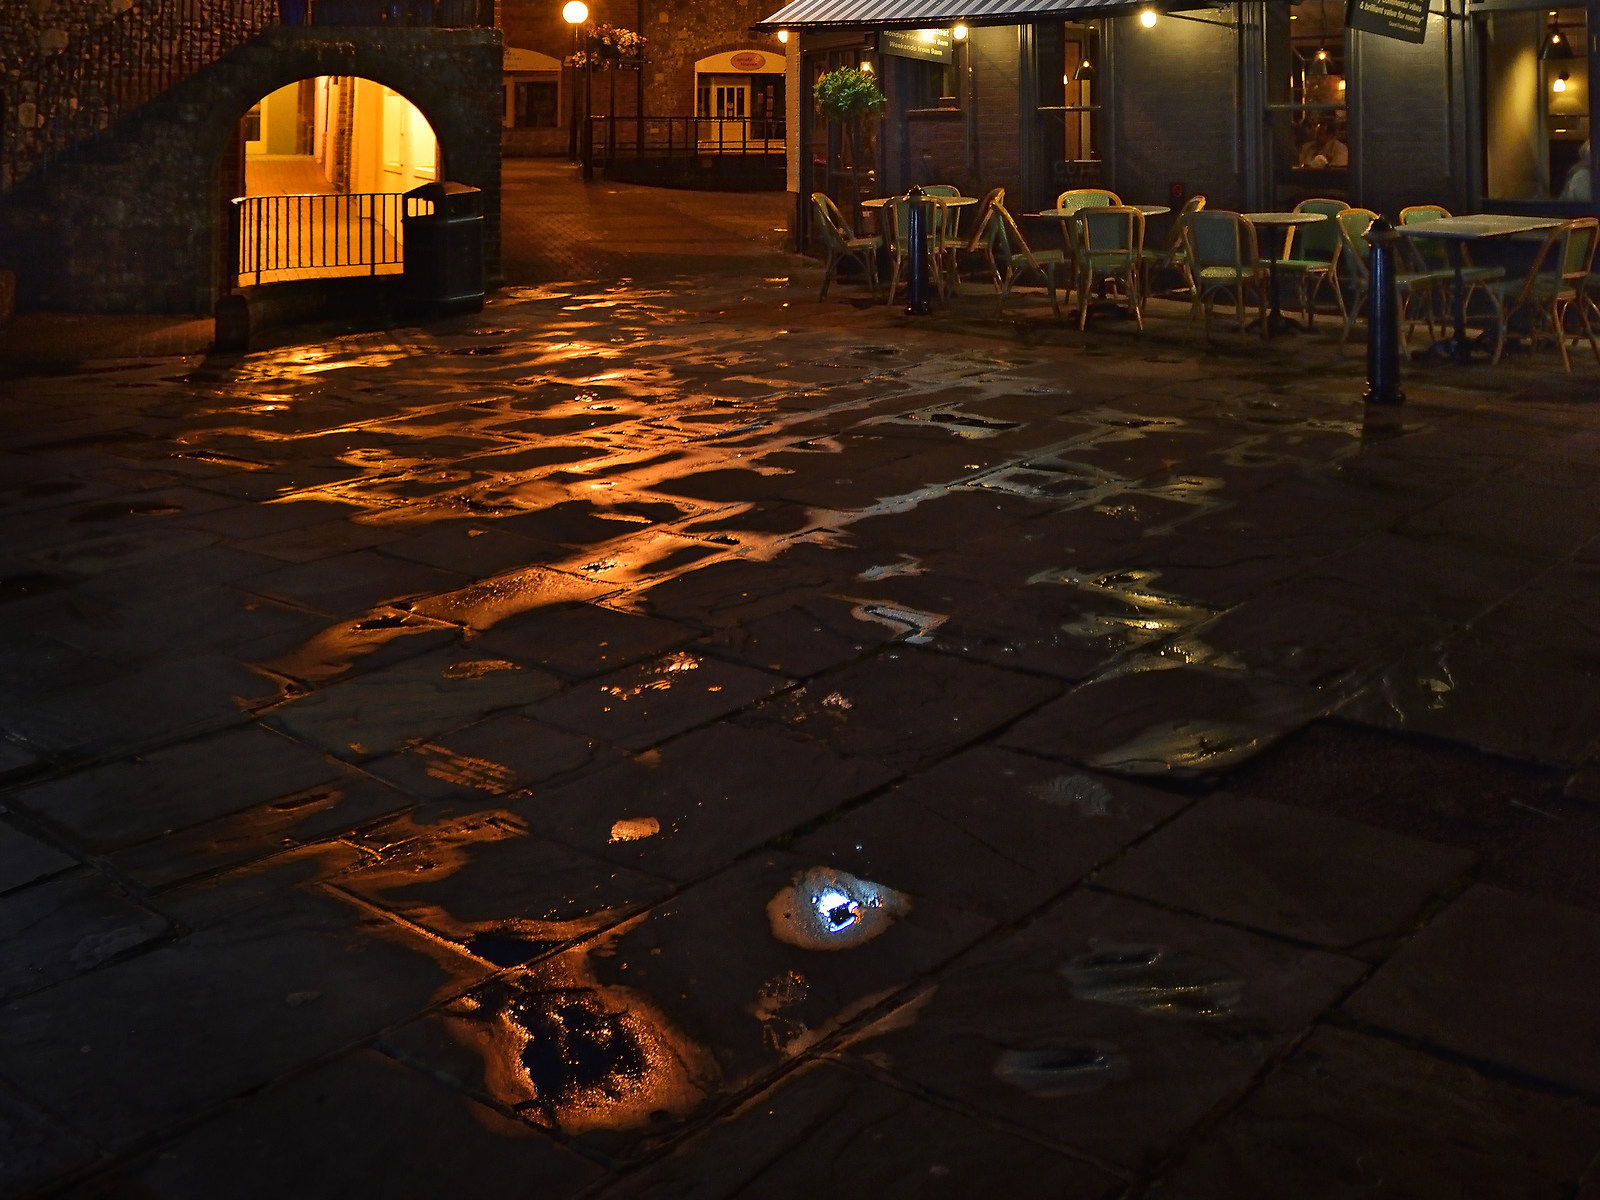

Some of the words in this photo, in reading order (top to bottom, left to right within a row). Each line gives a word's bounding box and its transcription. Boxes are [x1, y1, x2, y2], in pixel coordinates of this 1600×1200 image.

[1359, 1, 1364, 10] &
[1397, 10, 1405, 19] for
[888, 41, 917, 52] Weekends
[917, 46, 931, 55] from
[930, 48, 943, 56] 9am
